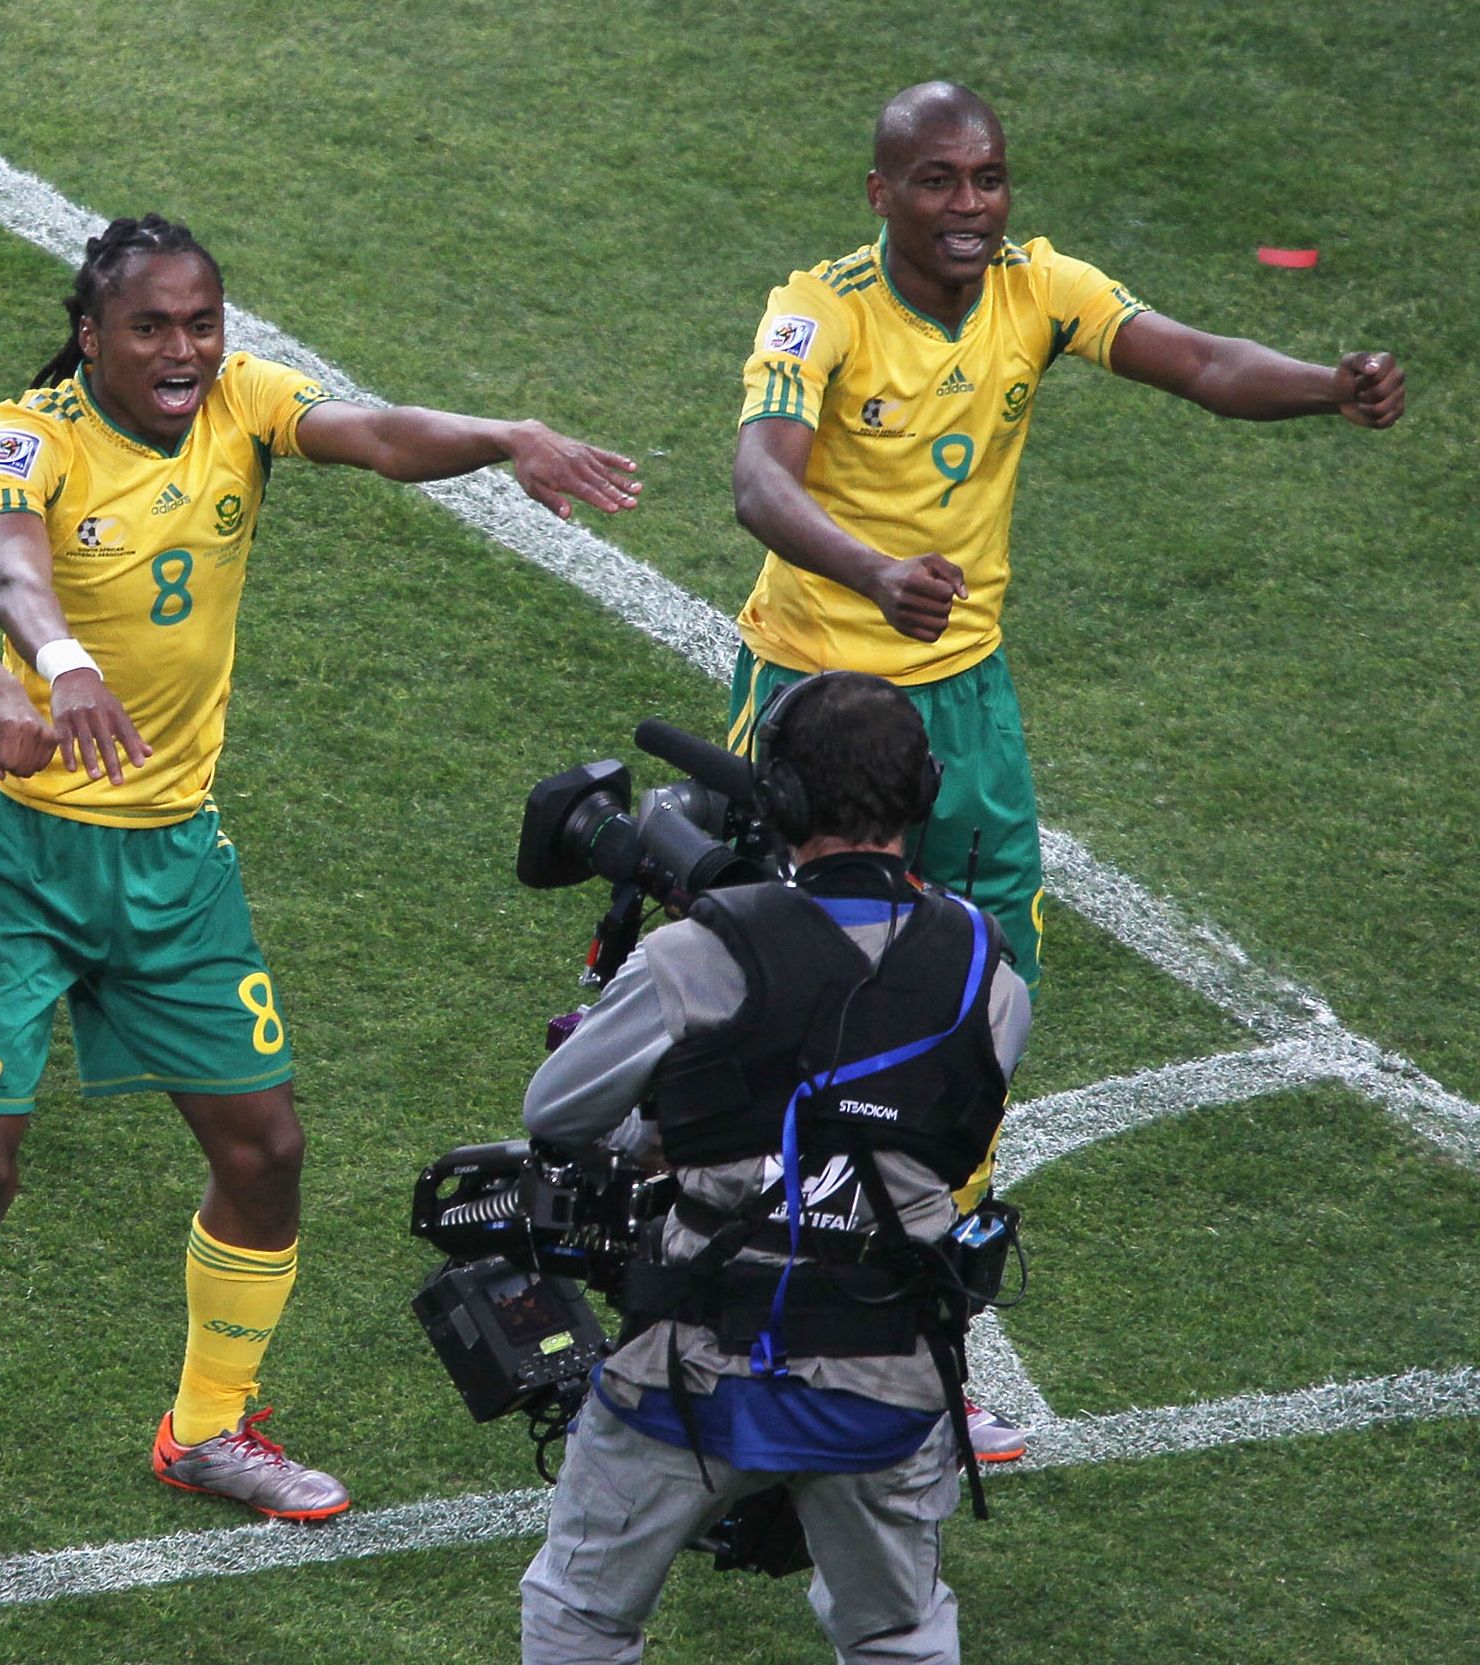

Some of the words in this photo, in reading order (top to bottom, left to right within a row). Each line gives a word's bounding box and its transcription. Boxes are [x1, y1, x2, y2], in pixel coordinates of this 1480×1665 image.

[936, 383, 975, 397] addas
[931, 433, 974, 508] 9
[151, 495, 191, 515] adidas
[149, 549, 193, 626] 8
[238, 971, 284, 1055] 8
[839, 1099, 898, 1121] STEADICAM
